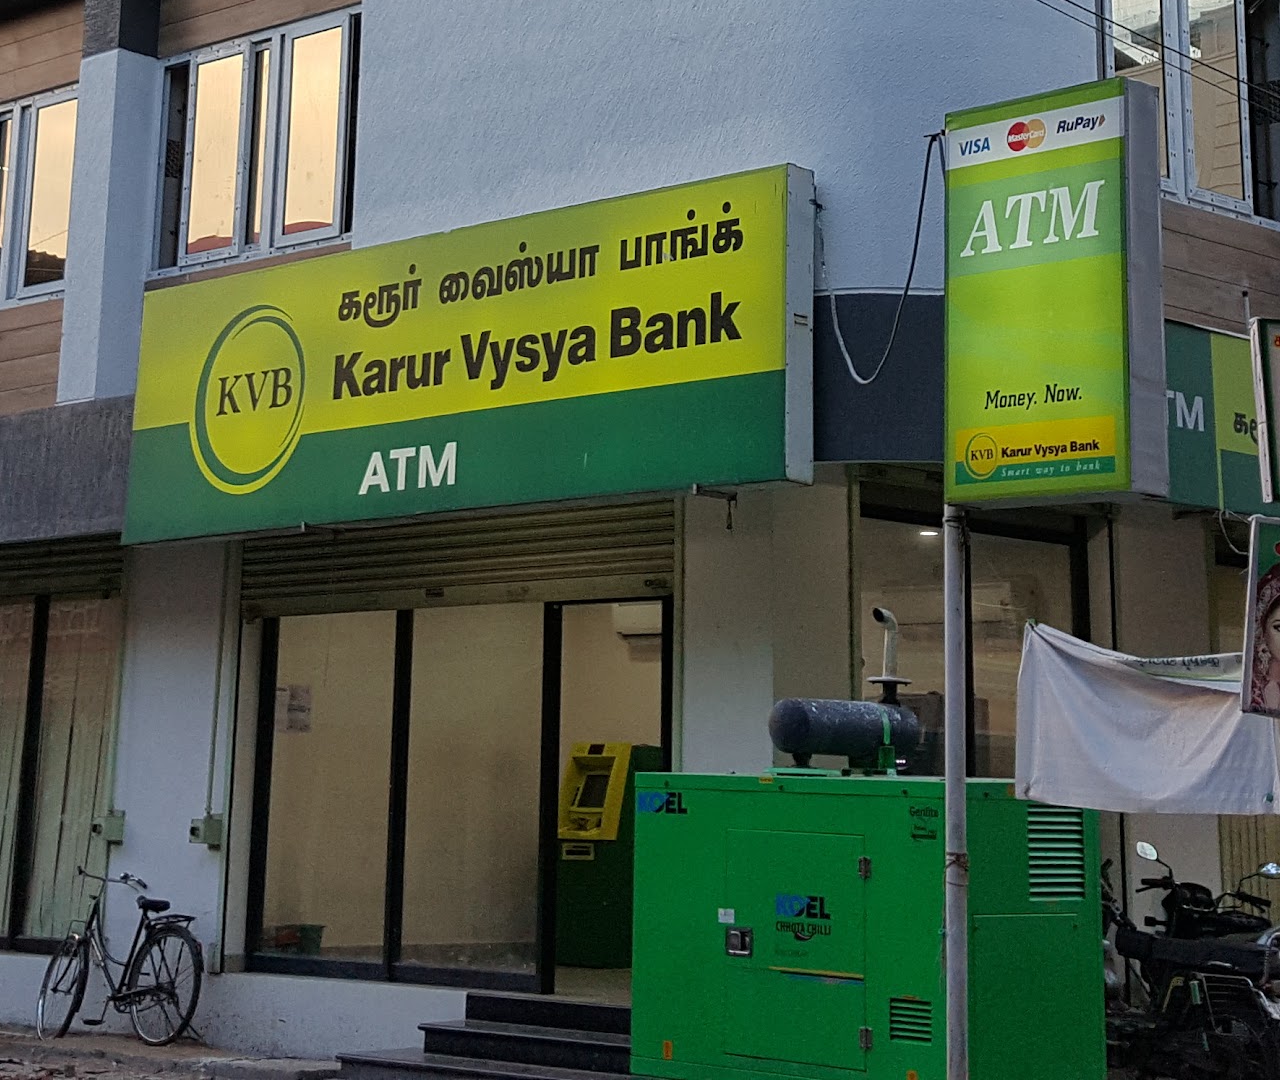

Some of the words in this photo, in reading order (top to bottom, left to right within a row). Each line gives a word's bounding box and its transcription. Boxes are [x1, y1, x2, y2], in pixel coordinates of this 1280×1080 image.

[1056, 115, 1099, 134] RuPay
[958, 137, 991, 157] VISA
[959, 179, 1106, 258] ATM
[337, 263, 423, 329] கரூர்
[438, 240, 600, 306] வைஸ்யா
[618, 201, 746, 272] பாங்க்
[332, 346, 452, 401] Karur
[459, 323, 597, 391] Vysya
[609, 290, 743, 359] Bank
[215, 367, 293, 417] KVB
[984, 387, 1038, 411] Money.
[1044, 382, 1083, 405] Now.
[970, 448, 995, 462] KVB
[1001, 446, 1033, 459] Karur
[1033, 443, 1068, 458] Vysya
[1069, 439, 1101, 453] Bank
[357, 440, 458, 495] ATM
[1001, 466, 1031, 478] Smart
[1076, 460, 1101, 472] bank
[637, 791, 689, 815] KOEL
[775, 894, 832, 920] KOEL
